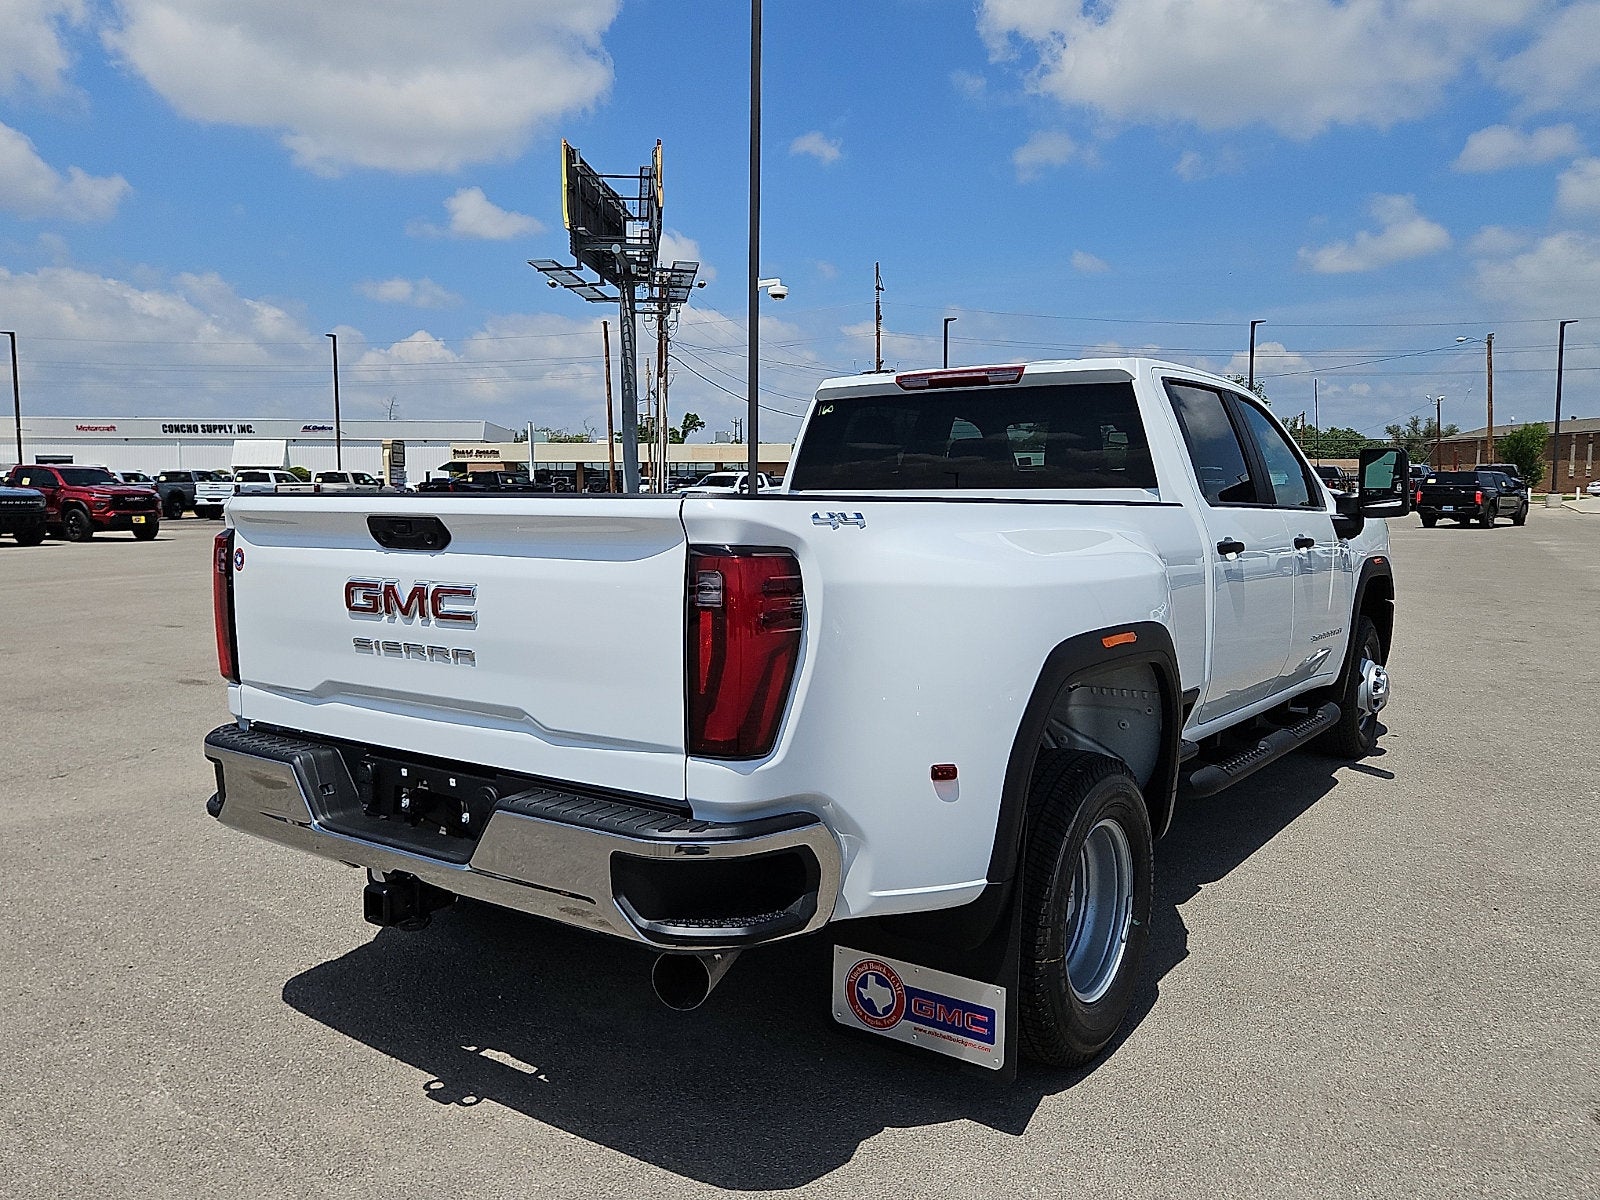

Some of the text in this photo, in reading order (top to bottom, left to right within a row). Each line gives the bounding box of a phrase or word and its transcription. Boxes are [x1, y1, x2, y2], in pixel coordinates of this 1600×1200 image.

[75, 424, 117, 432] Motorcraft
[161, 423, 256, 435] CONCHO SUPPLY, INC.
[344, 575, 479, 631] GMC
[352, 637, 477, 667] SIERRA
[869, 962, 888, 975] Buick
[911, 996, 988, 1035] GMC
